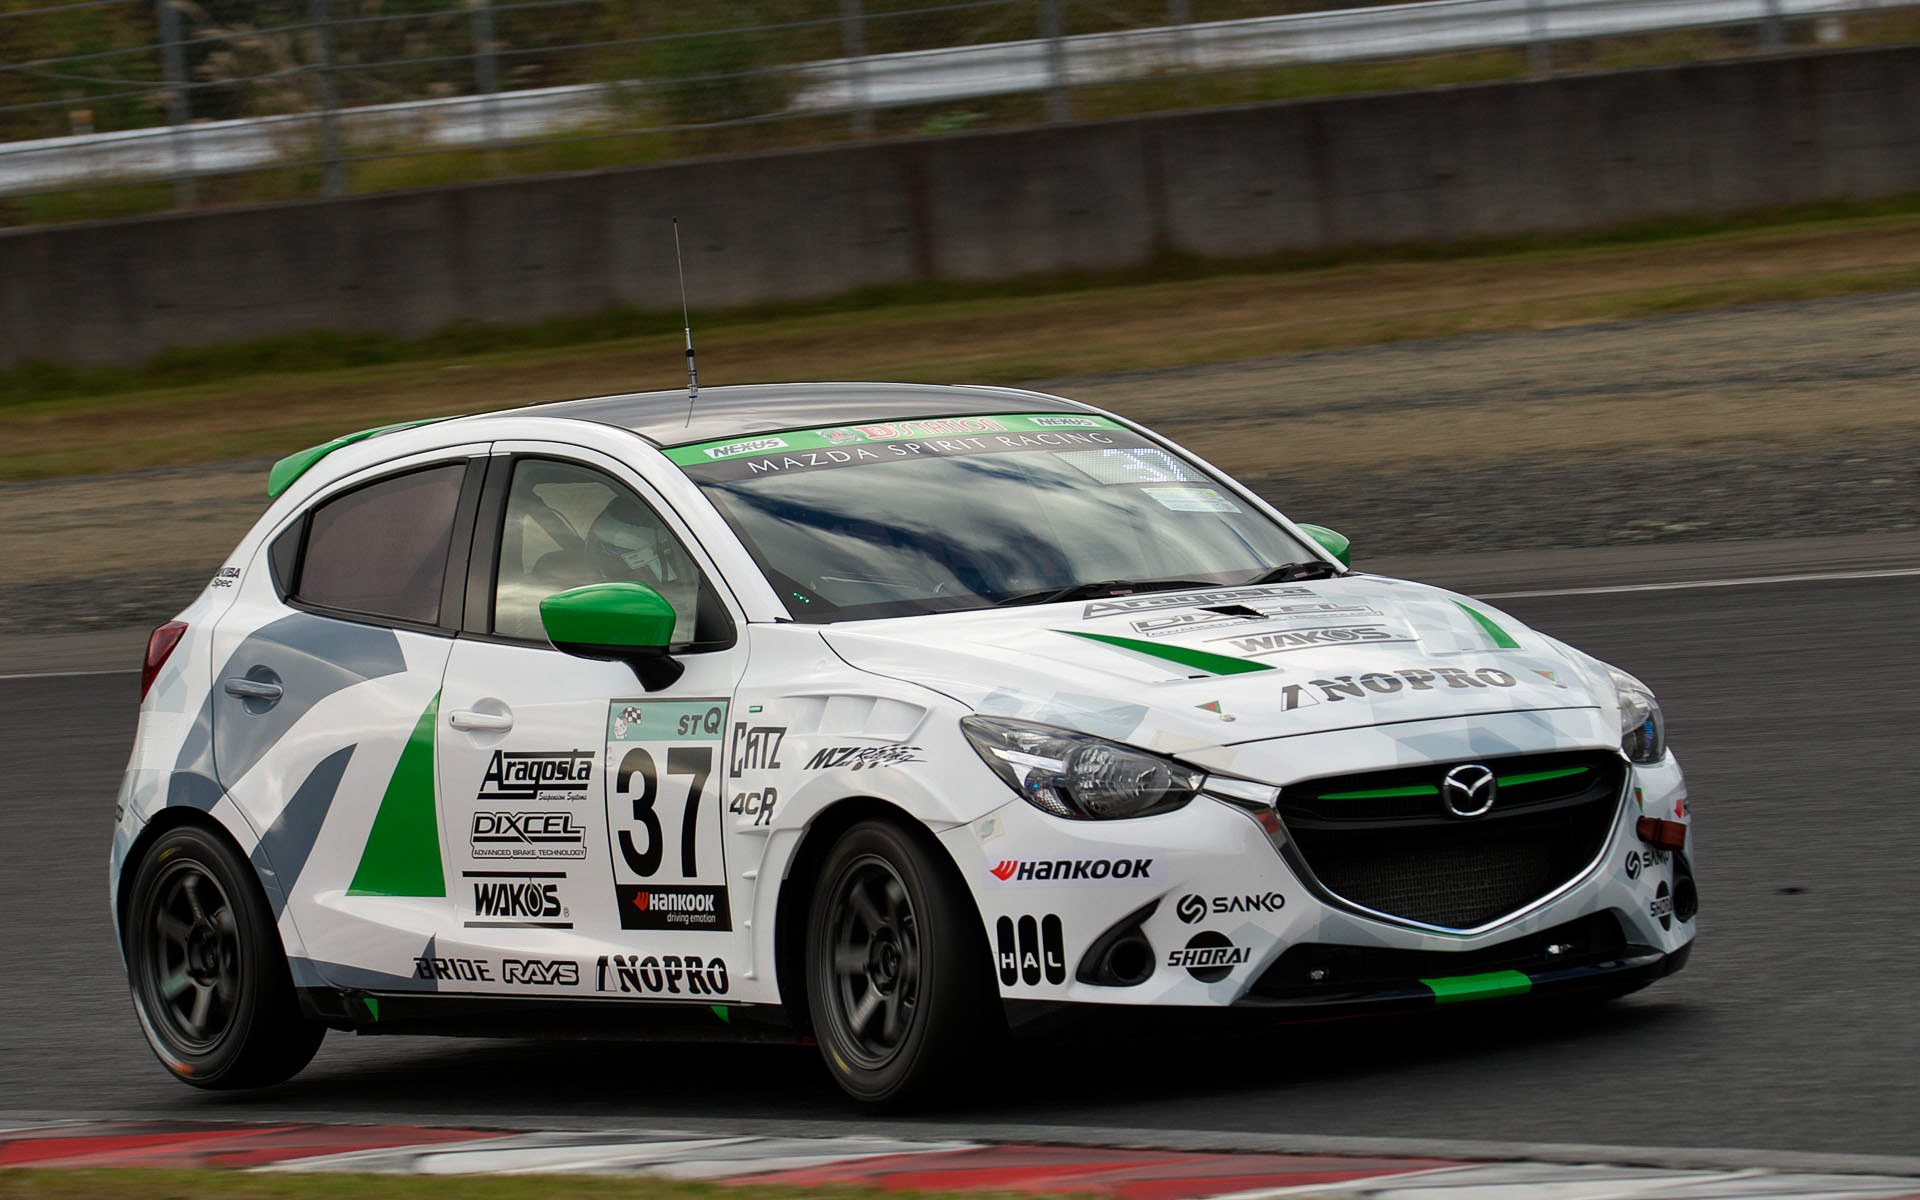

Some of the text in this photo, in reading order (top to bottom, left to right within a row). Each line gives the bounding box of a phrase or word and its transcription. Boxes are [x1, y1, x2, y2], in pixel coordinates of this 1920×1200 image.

[1035, 417, 1093, 426] NEXUS
[713, 438, 780, 458] NEXUS
[747, 432, 1113, 474] MAZDA SPIRIT RACING
[1103, 448, 1187, 482] 37
[212, 578, 232, 588] Spec
[729, 722, 787, 778] CATZ
[477, 748, 596, 800] Aragosta
[616, 747, 713, 878] 37
[729, 787, 777, 826] 4CR
[473, 815, 581, 842] DIXCEL
[1212, 892, 1286, 914] SANKO
[667, 913, 716, 924] driving emotion
[413, 957, 495, 982] BRIDE
[1001, 952, 1062, 969] HAL
[1168, 947, 1251, 967] SHORAI
[503, 959, 579, 986] RAYS
